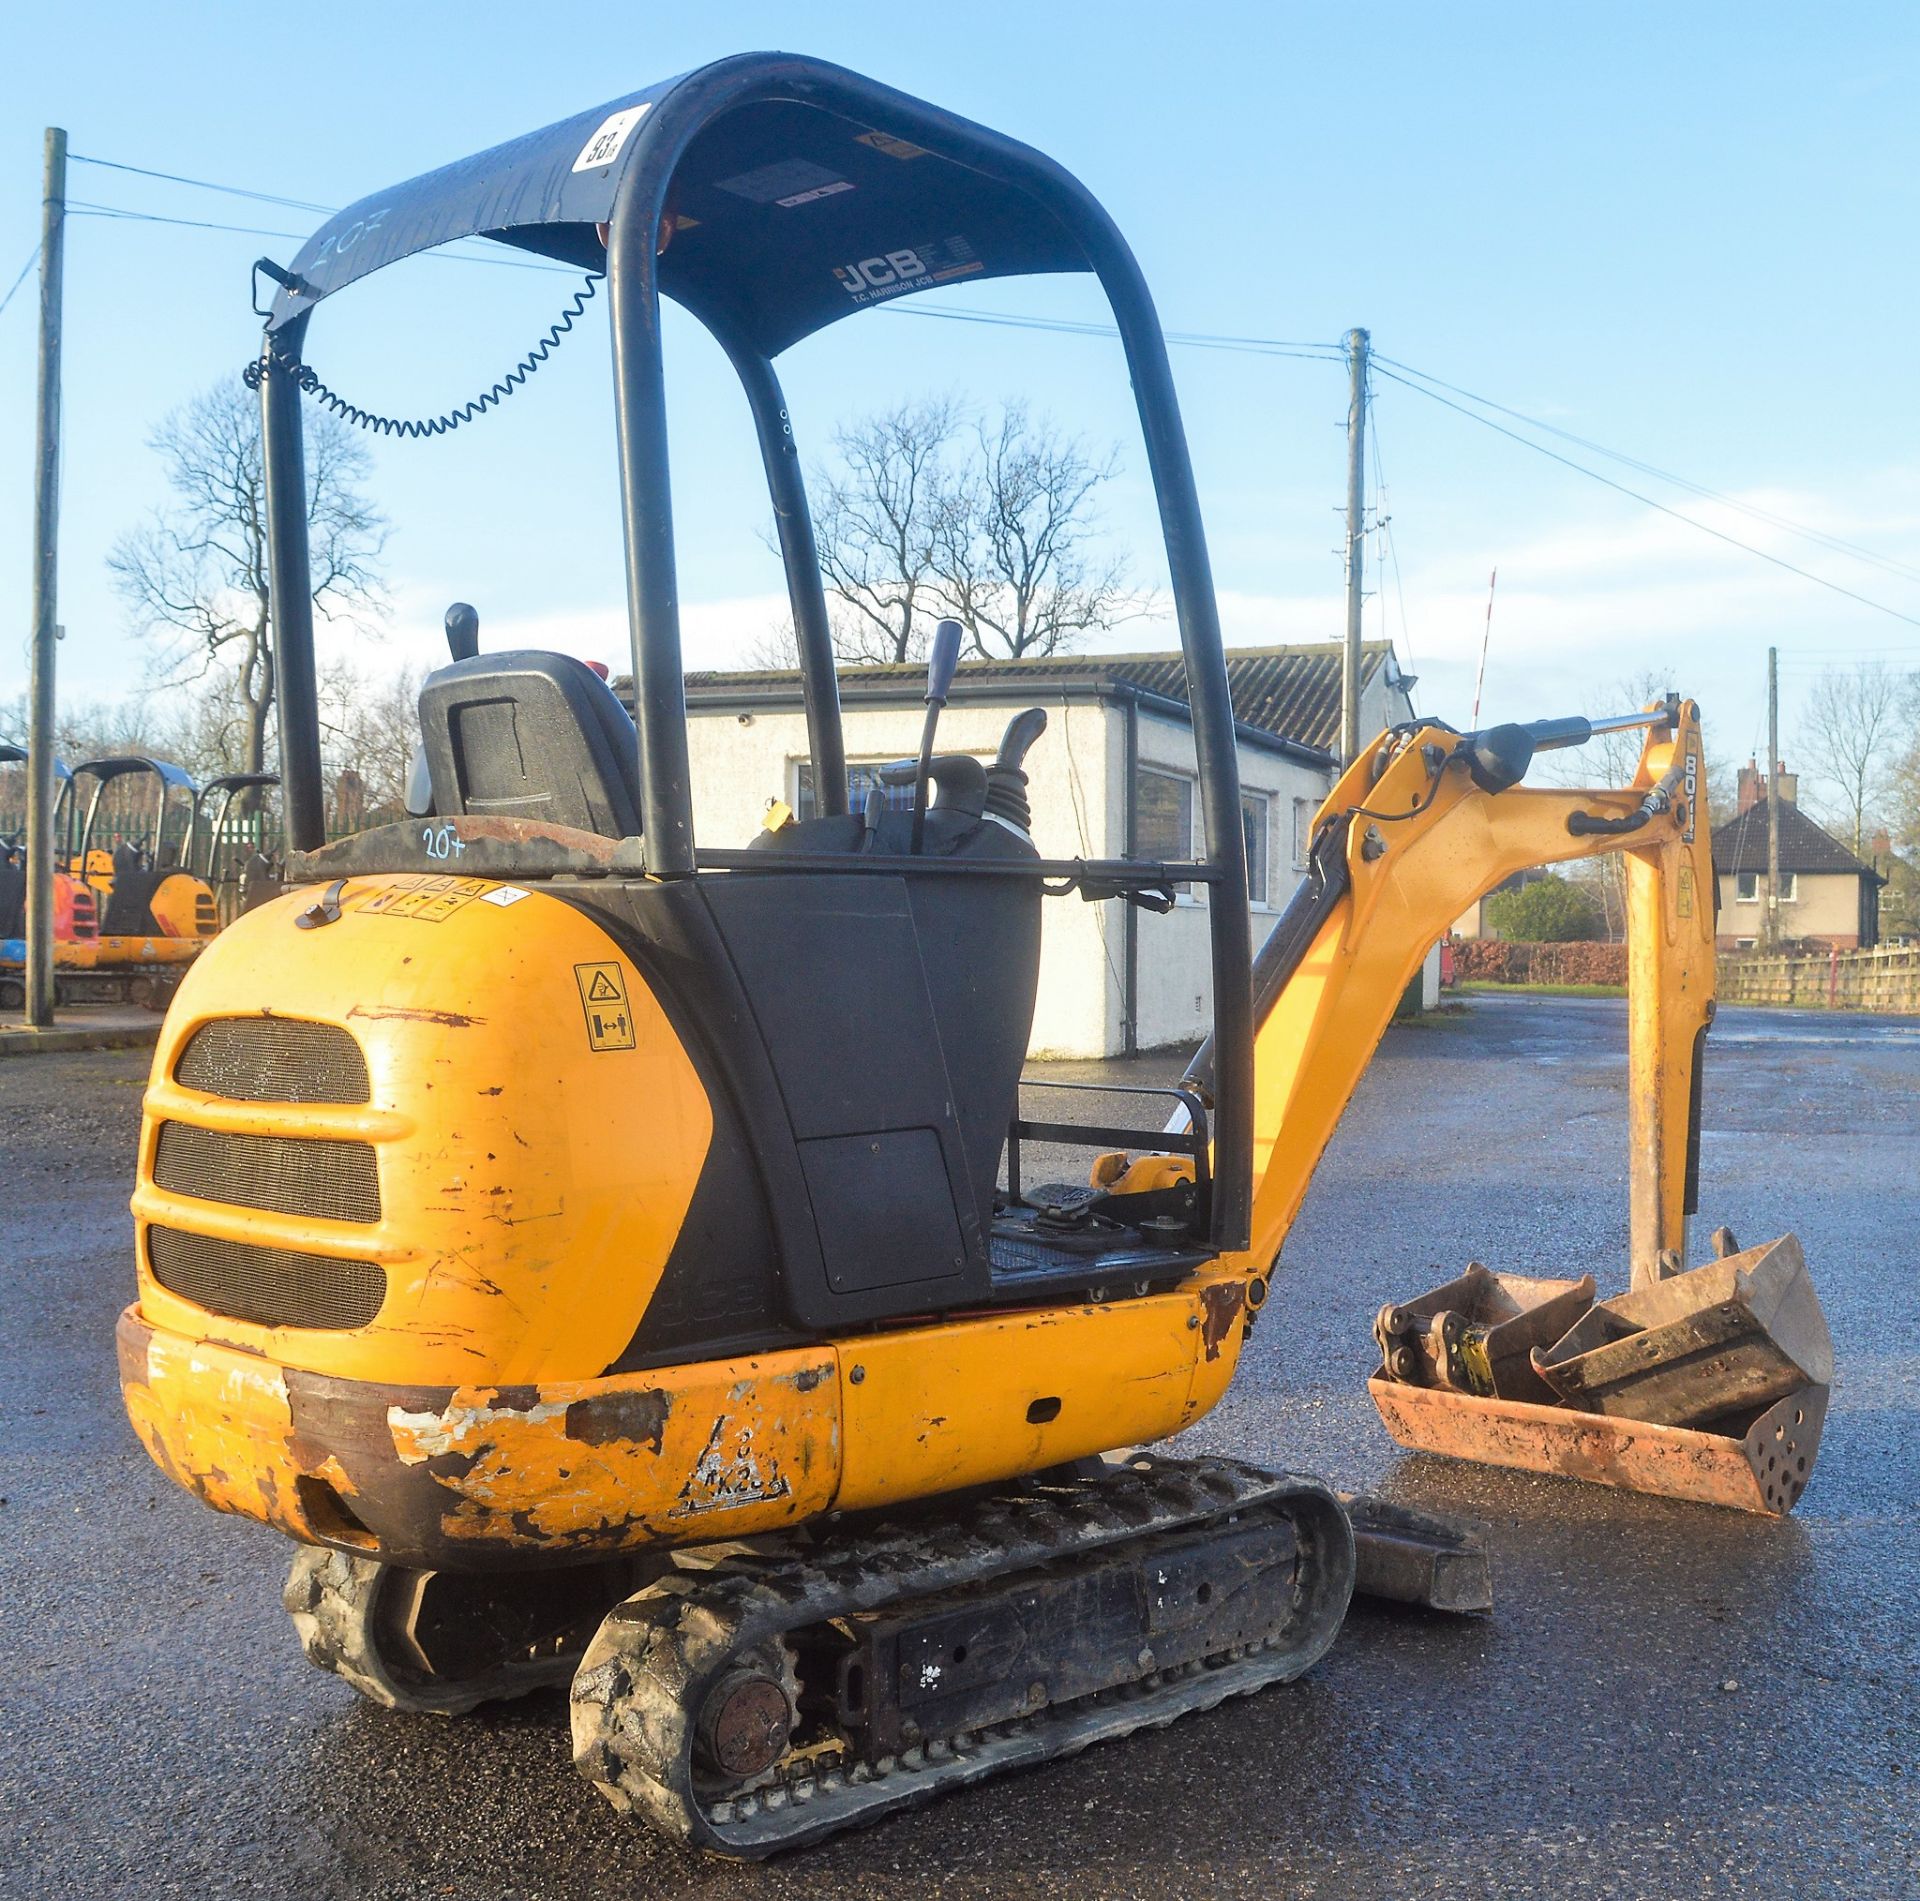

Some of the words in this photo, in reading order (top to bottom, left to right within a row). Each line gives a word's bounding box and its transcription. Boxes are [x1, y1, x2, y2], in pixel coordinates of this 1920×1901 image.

[586, 131, 618, 163] 93
[310, 208, 392, 270] 207
[842, 249, 926, 293] JCB
[870, 282, 914, 299] HARRISON
[916, 275, 934, 288] JCB
[423, 825, 466, 859] 207
